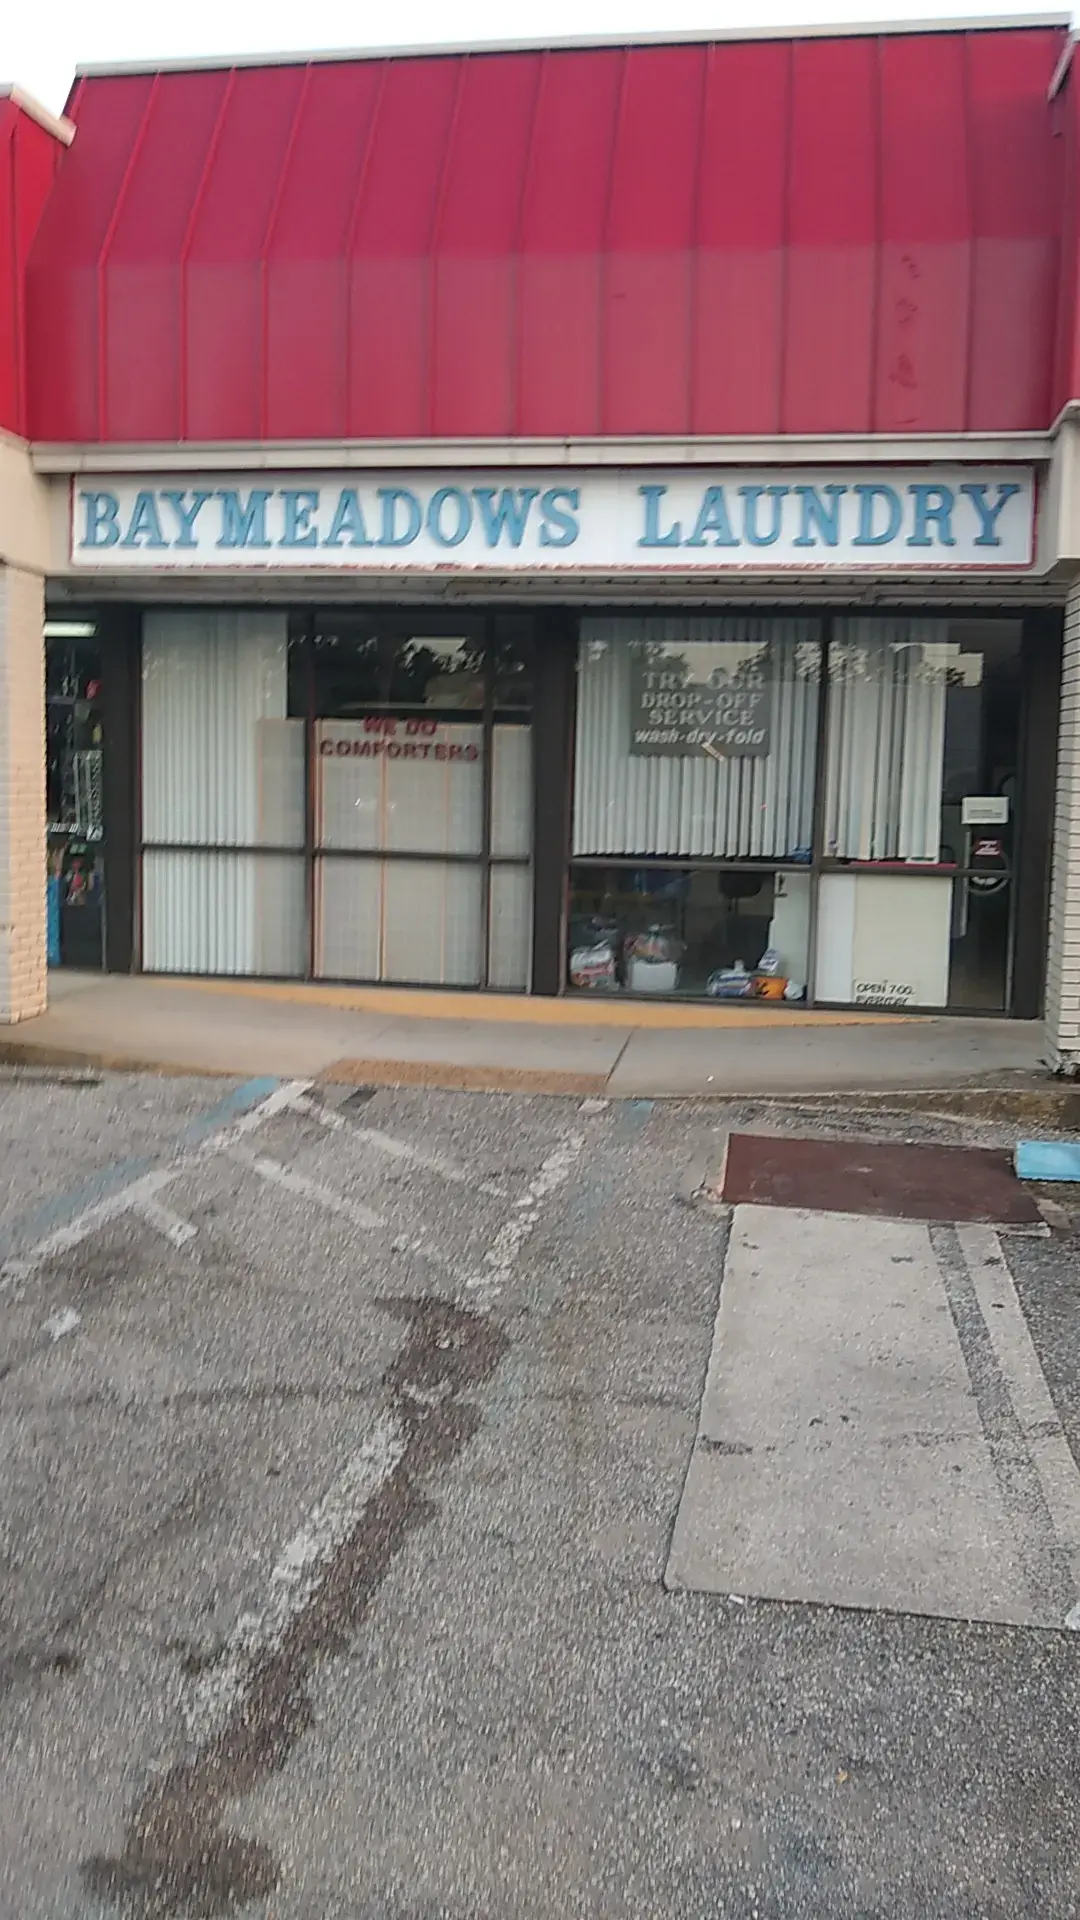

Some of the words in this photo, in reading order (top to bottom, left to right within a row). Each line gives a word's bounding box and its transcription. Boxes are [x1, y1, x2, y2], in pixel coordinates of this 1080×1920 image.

[79, 487, 580, 549] BAYMEADOWS
[637, 483, 1021, 548] LAUNDRY
[642, 671, 694, 689] TRY
[640, 691, 764, 709] DROP-OFF
[362, 716, 396, 735] WE
[405, 717, 437, 736] DO
[649, 709, 755, 726] SERVICE
[634, 728, 767, 745] wash-dry-fold
[319, 739, 479, 761] COMFORTERS
